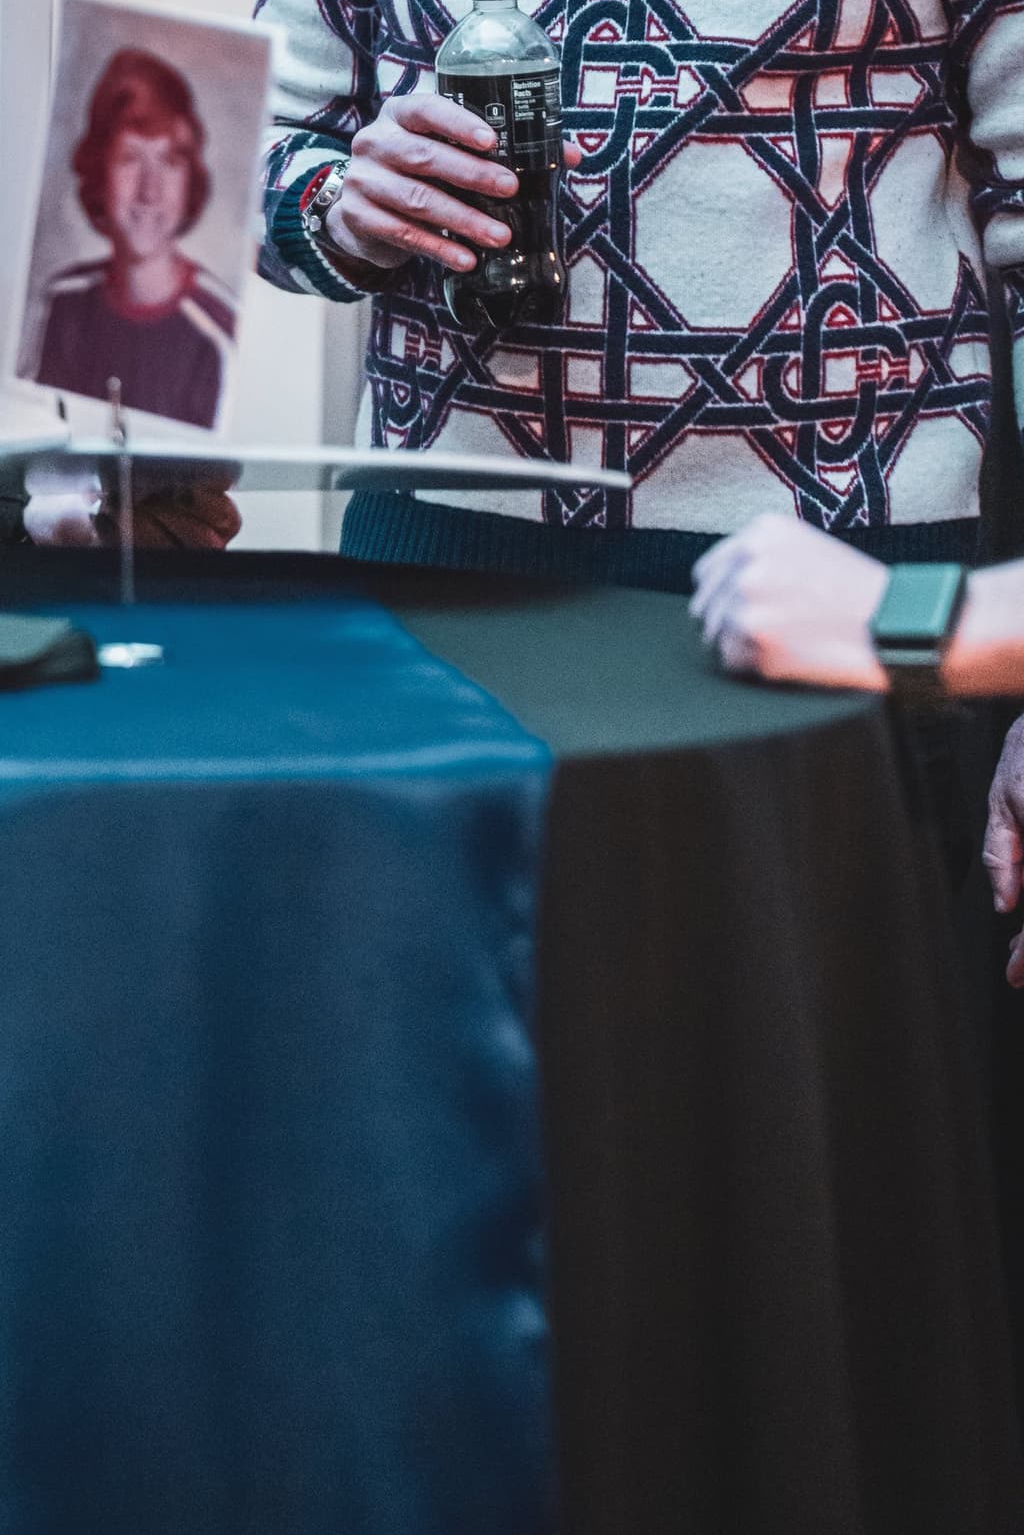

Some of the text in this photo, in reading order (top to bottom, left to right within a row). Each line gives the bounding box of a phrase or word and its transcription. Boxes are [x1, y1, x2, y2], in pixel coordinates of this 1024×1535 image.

[513, 81, 541, 90] Nutrition
[514, 89, 532, 98] Facts
[492, 106, 498, 116] 0
